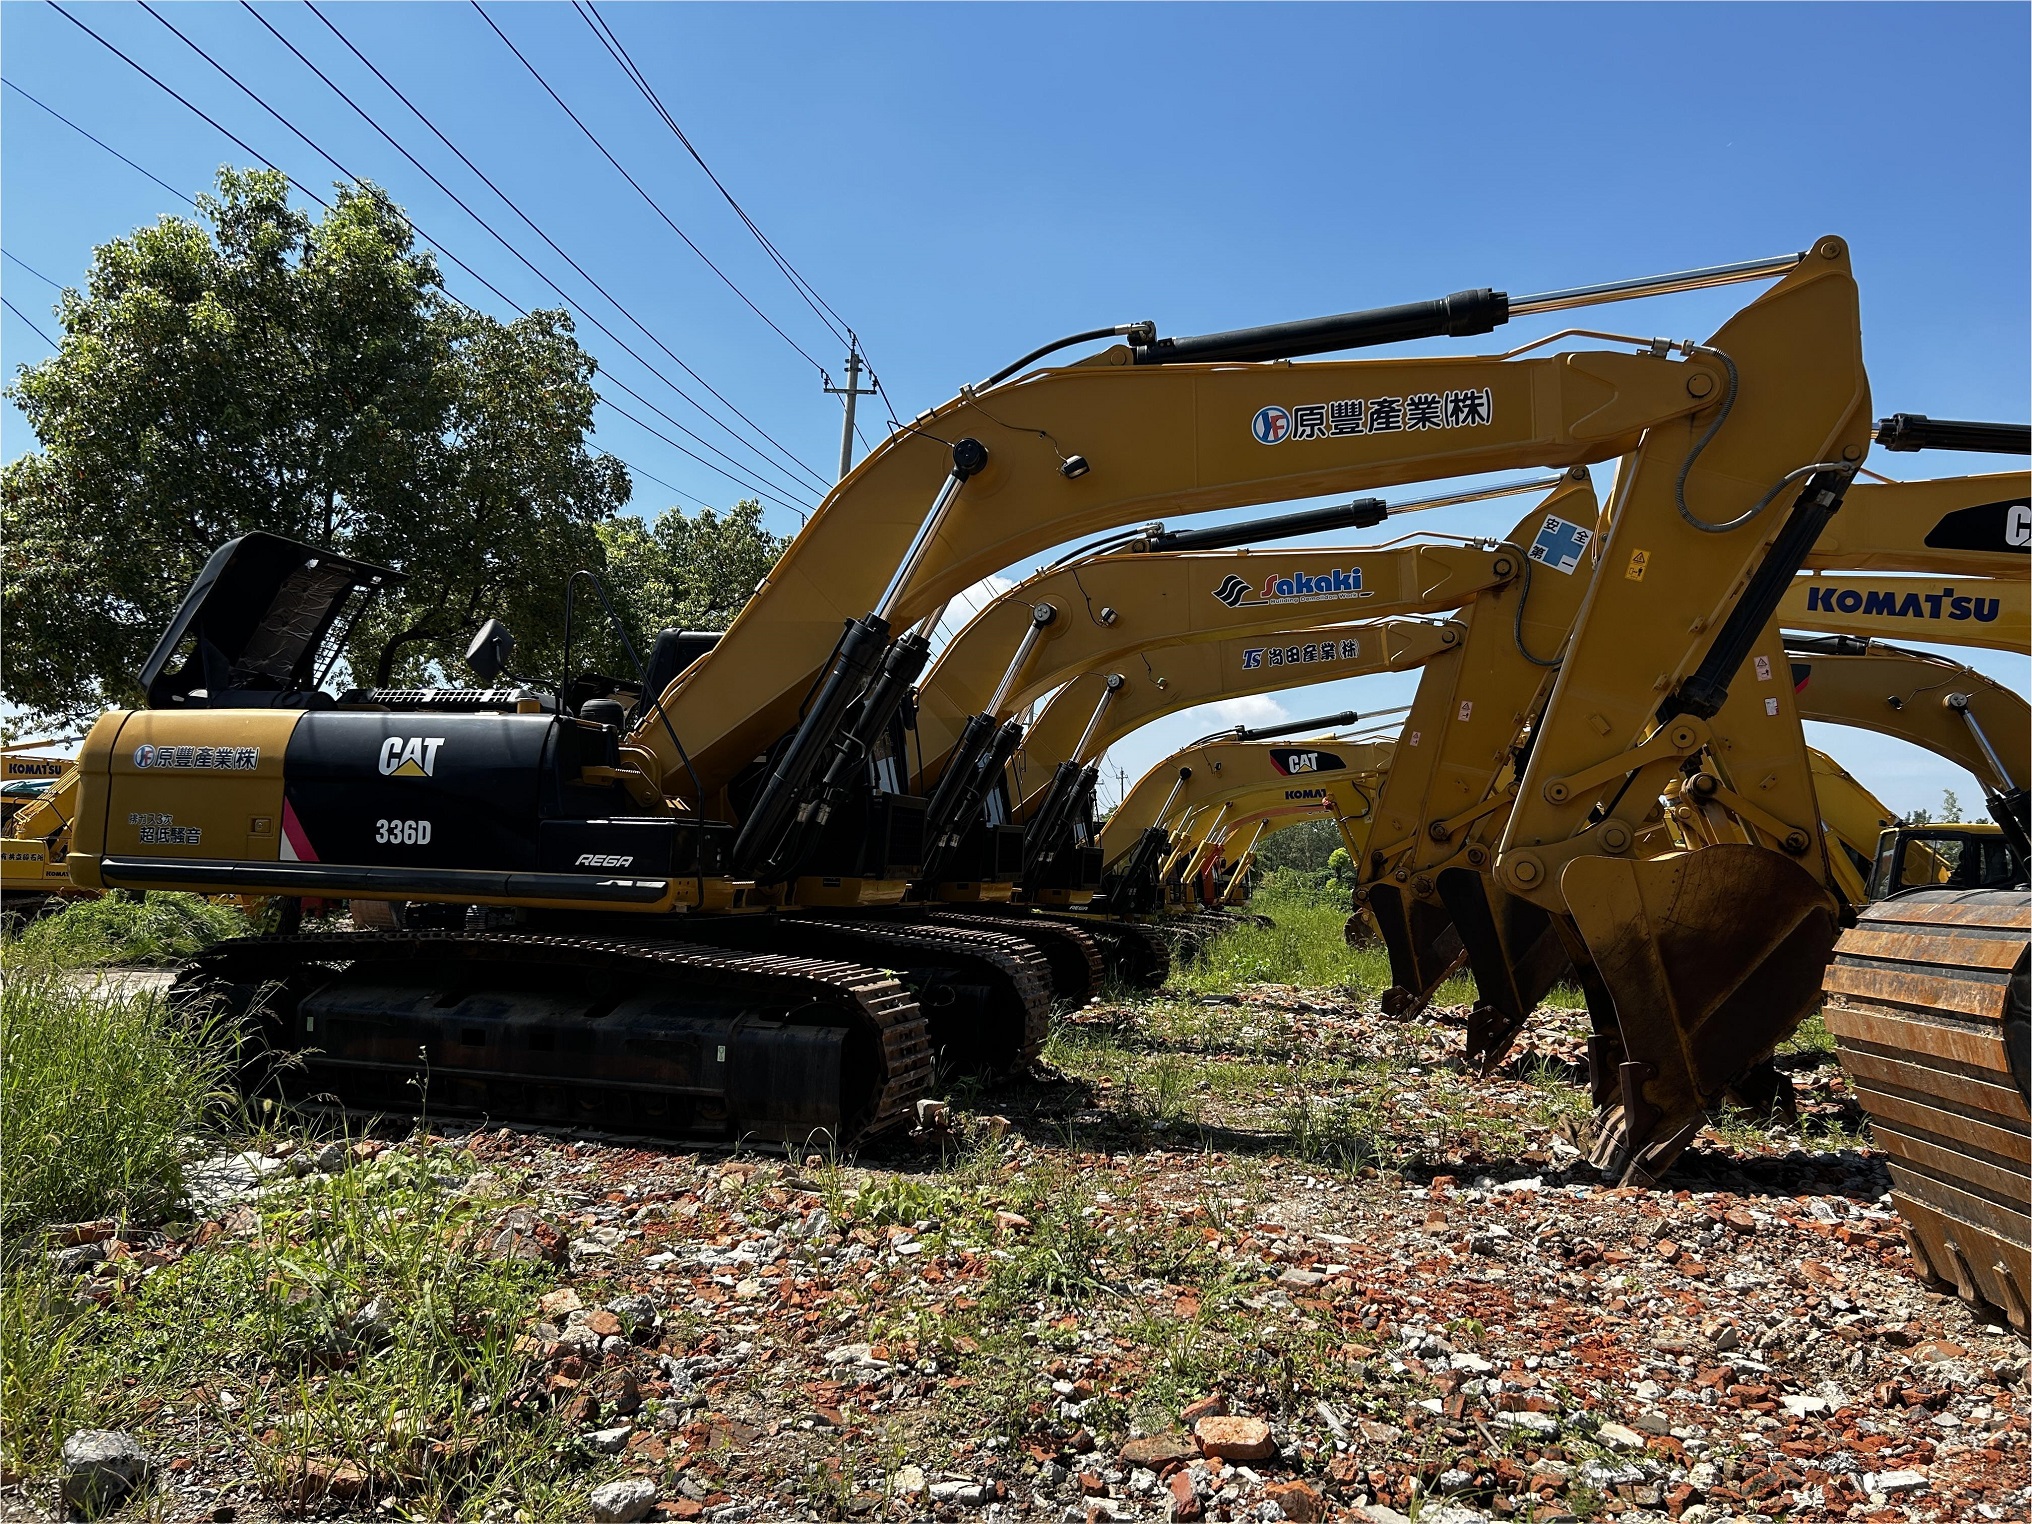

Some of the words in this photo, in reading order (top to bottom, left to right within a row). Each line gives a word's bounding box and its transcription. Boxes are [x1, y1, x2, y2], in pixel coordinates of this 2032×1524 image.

[1260, 567, 1363, 598] Sakaki
[1807, 586, 2001, 623] KOMATSU
[378, 736, 446, 777] CAT
[1289, 753, 1318, 774] CAT
[8, 762, 62, 775] KOMATSU
[1285, 788, 1327, 799] KOMAT
[375, 819, 432, 845] 336D
[575, 854, 634, 868] REGA
